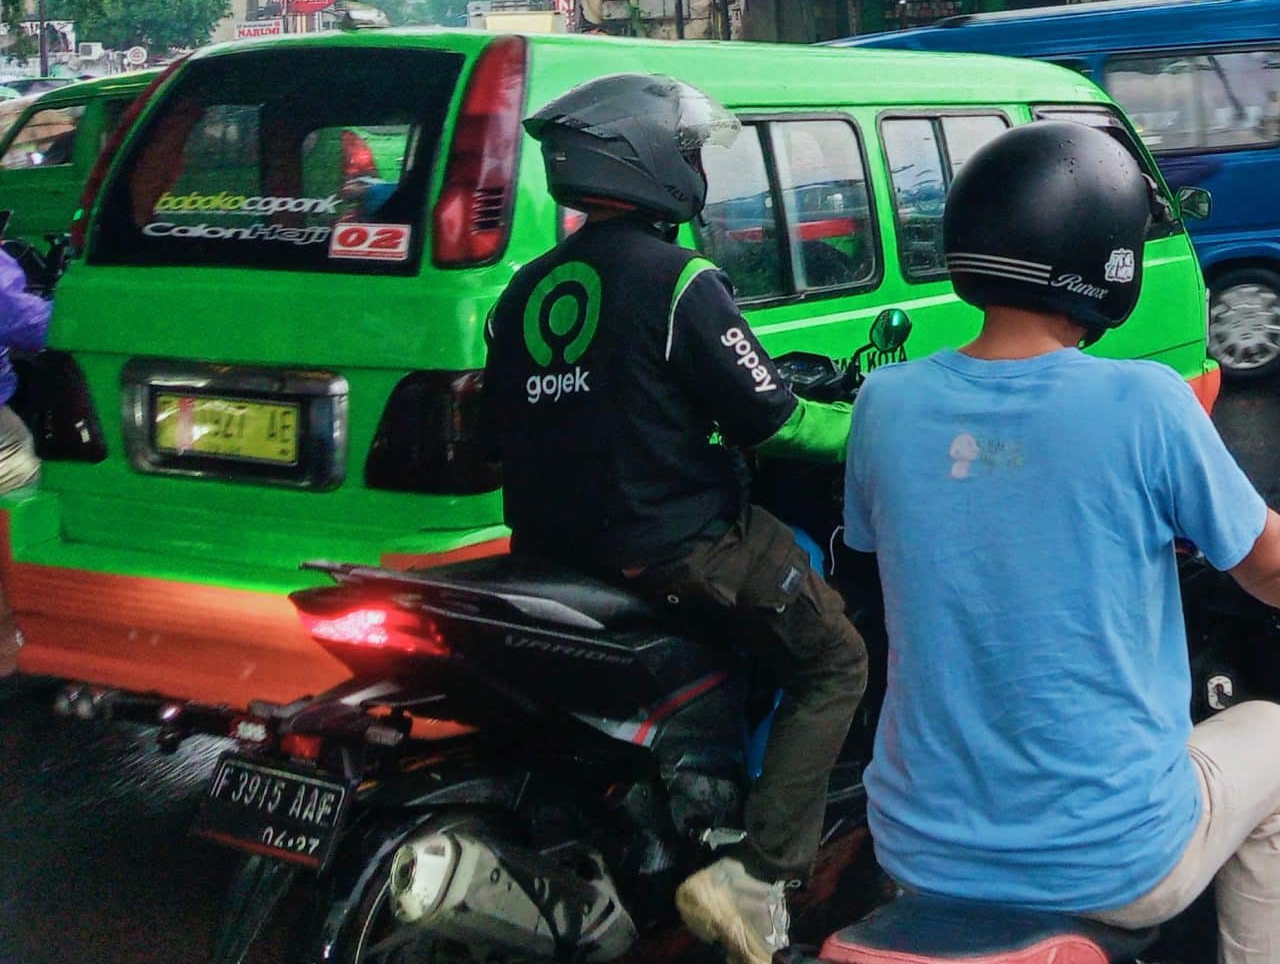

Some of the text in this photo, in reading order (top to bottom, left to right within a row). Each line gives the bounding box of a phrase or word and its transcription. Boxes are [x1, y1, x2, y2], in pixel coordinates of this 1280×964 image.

[336, 226, 405, 248] 02
[721, 327, 777, 393] gopay
[526, 367, 590, 404] gojek
